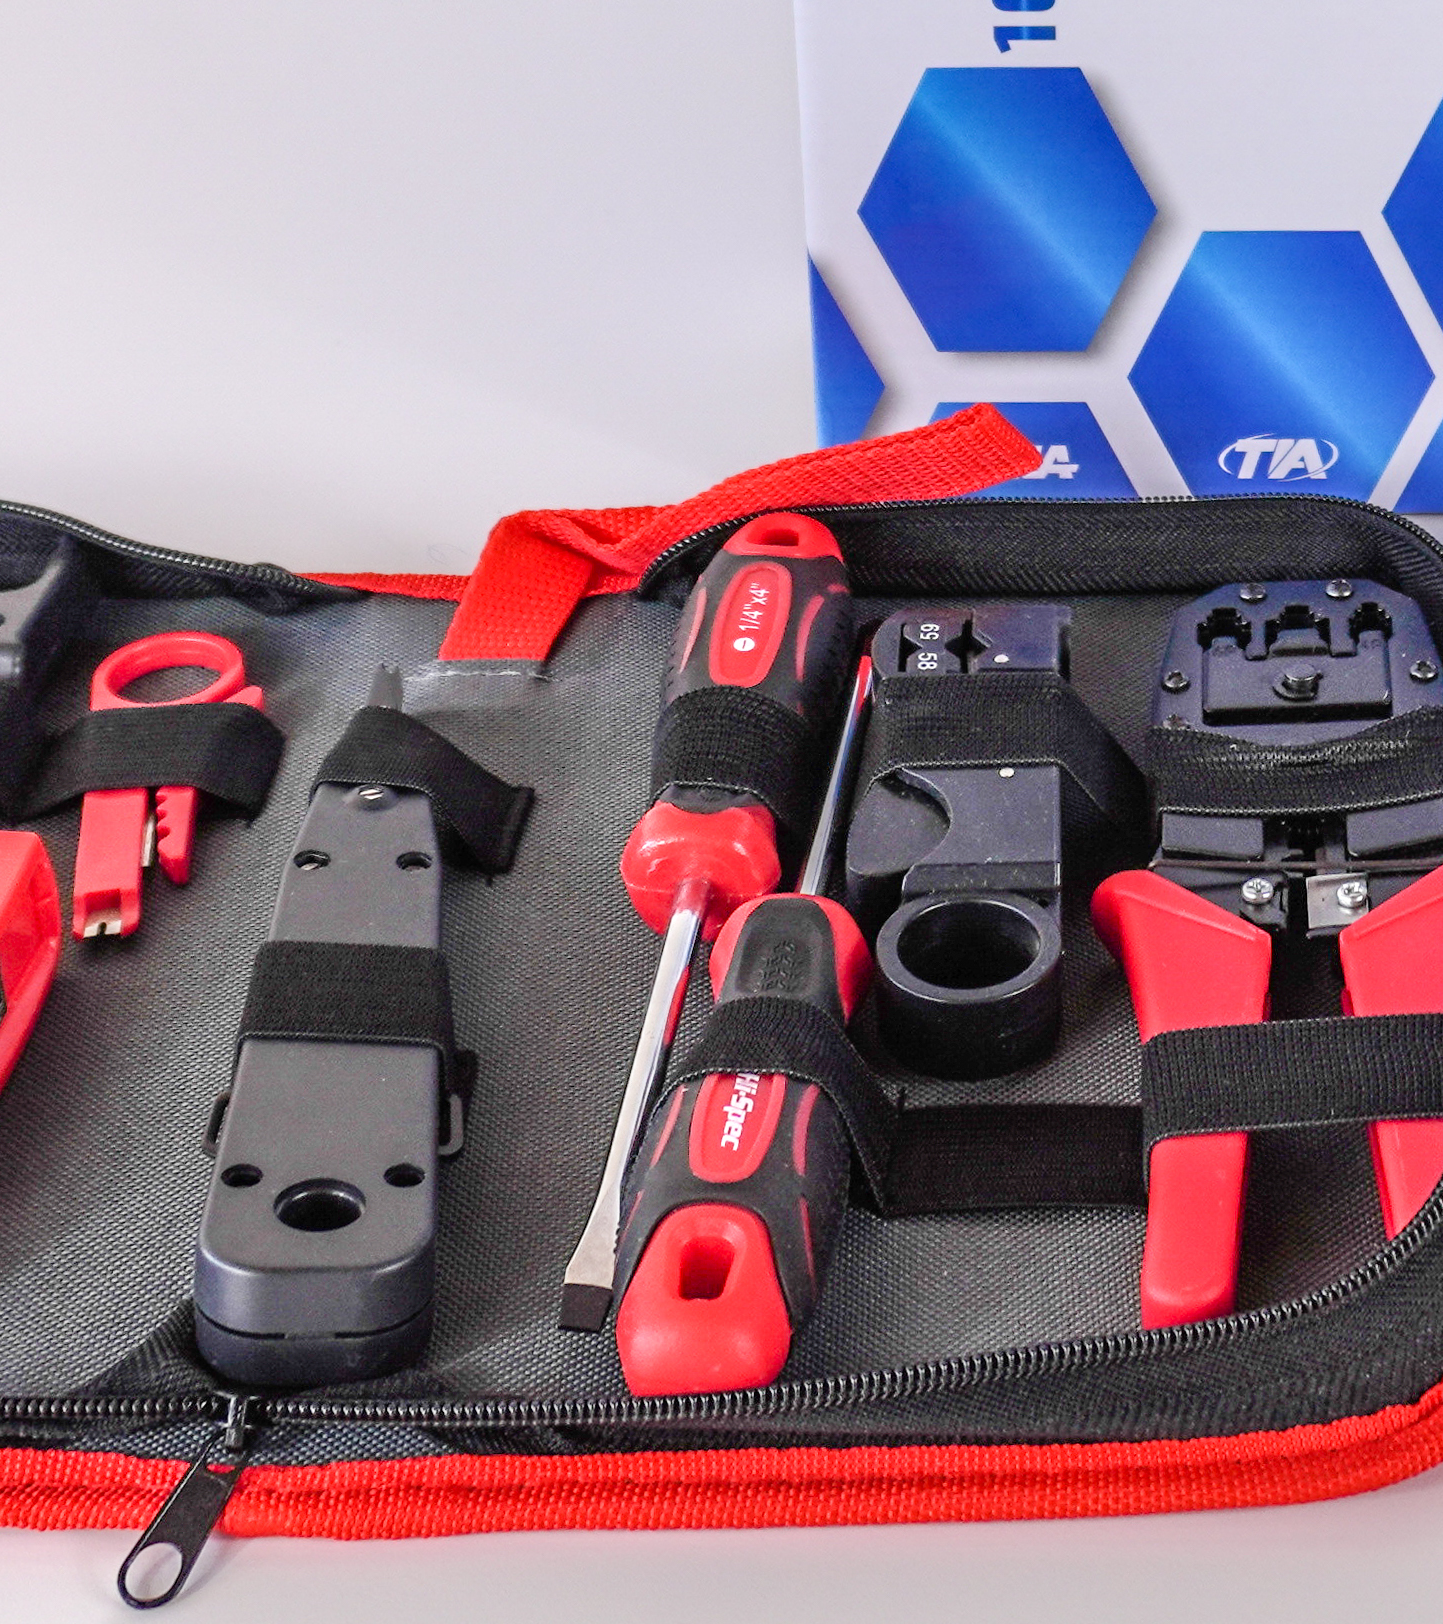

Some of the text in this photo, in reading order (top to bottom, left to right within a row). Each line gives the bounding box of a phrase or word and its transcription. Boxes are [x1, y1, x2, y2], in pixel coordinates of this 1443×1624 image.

[1233, 438, 1328, 480] TIA
[920, 623, 940, 641] 59
[917, 651, 939, 671] 58
